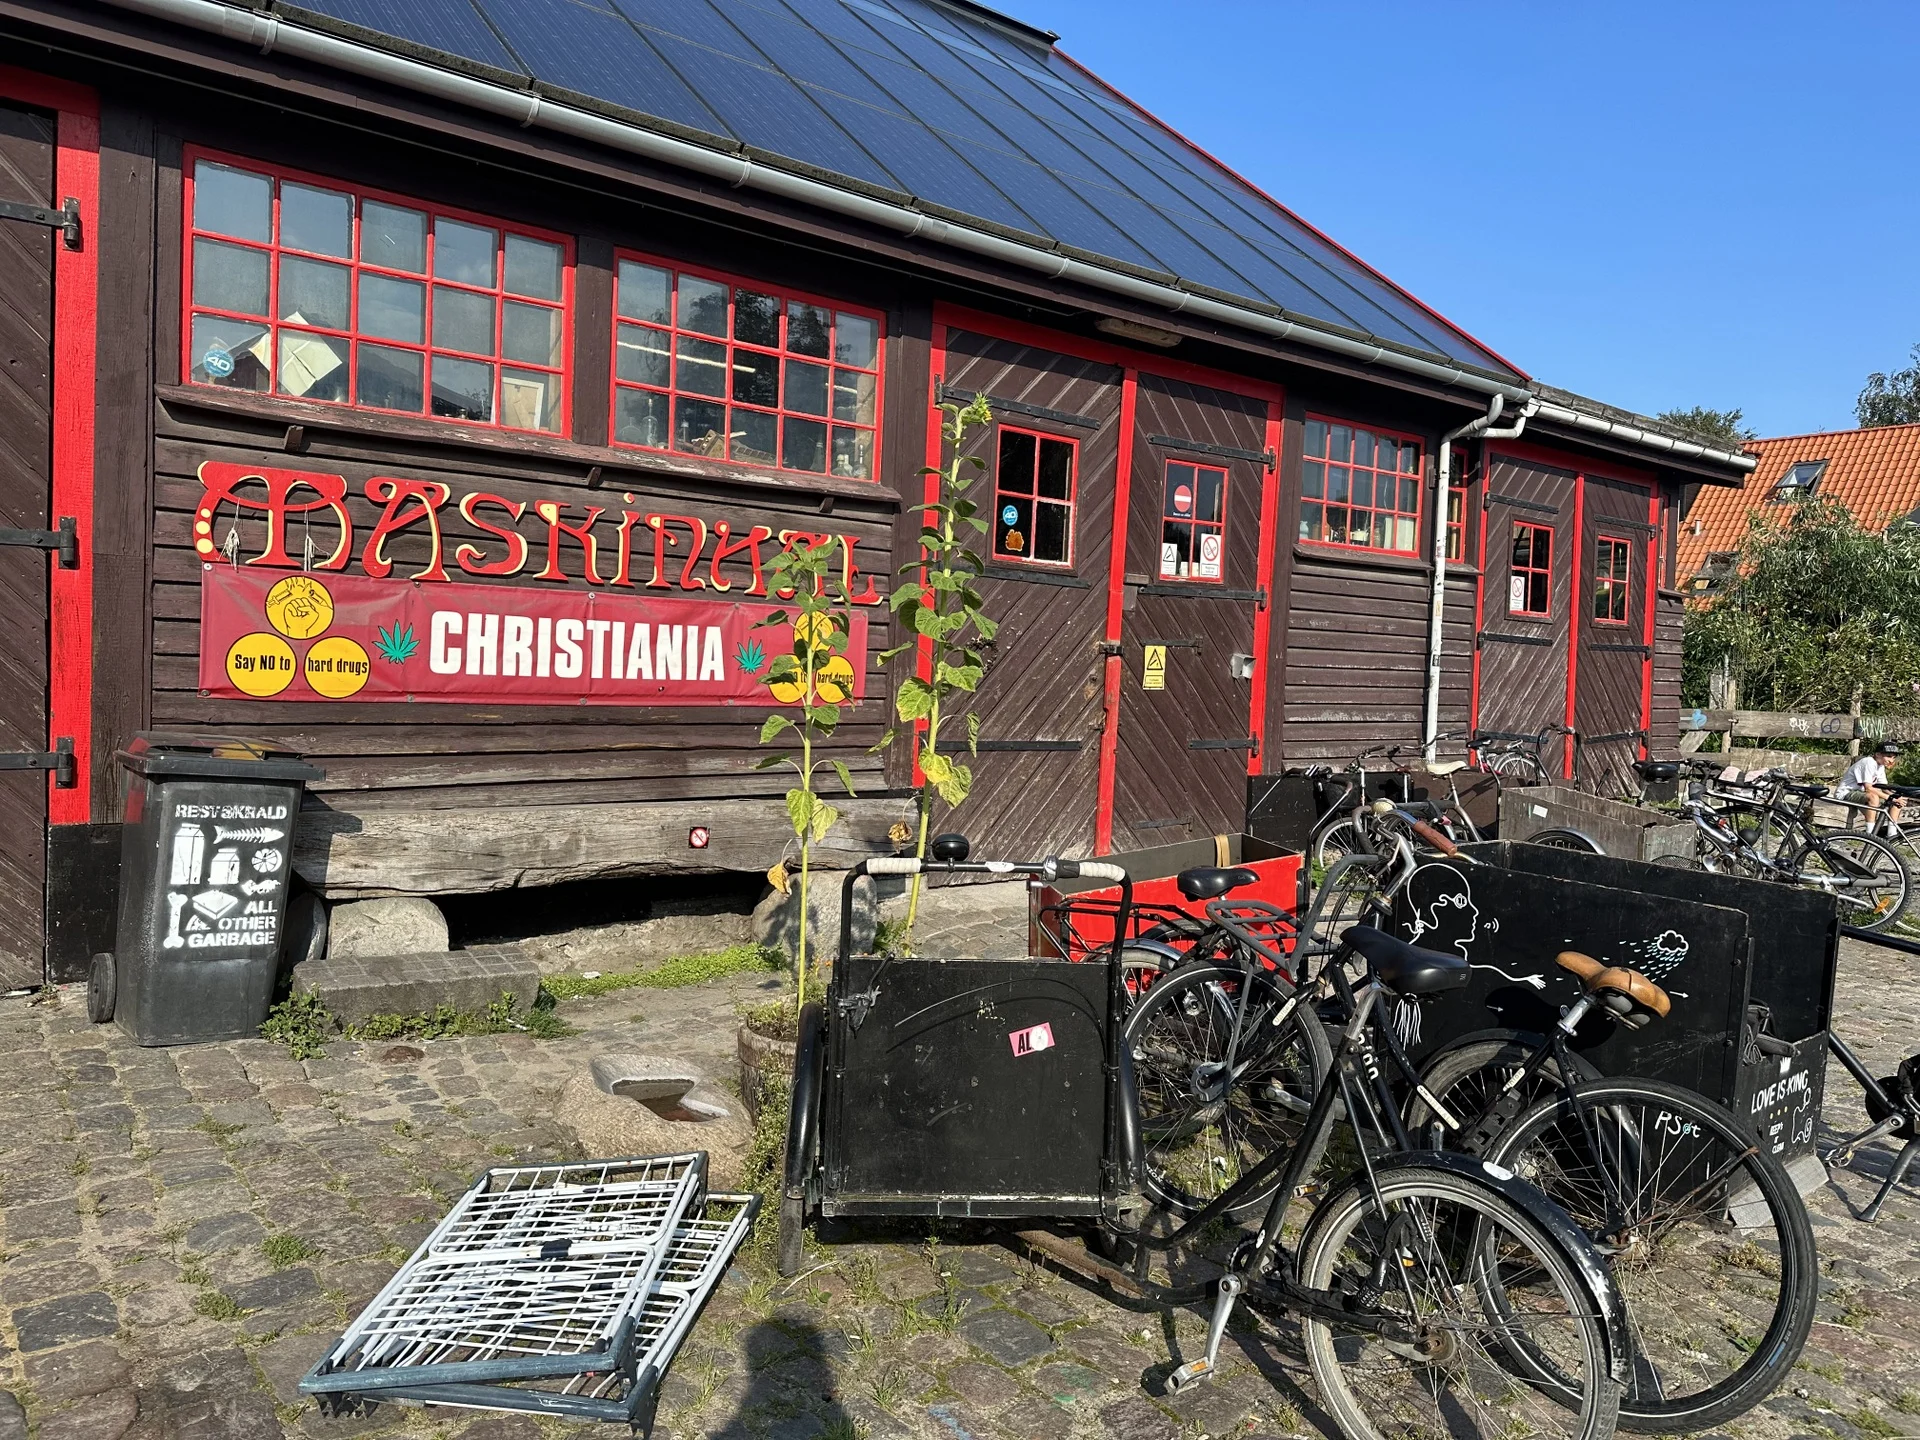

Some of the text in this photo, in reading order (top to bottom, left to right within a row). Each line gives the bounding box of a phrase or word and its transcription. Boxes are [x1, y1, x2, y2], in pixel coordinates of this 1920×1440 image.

[429, 610, 725, 681] CHRISTIANIA
[235, 654, 368, 676] Say NO to hard drugs
[817, 672, 832, 684] hard
[1821, 718, 1841, 734] 60
[245, 900, 277, 915] ALL
[218, 916, 276, 931] OTHER
[188, 931, 275, 948] GARBAGE
[1751, 1069, 1809, 1115] LOVE IS KING
[1540, 1352, 1579, 1387] UNION
